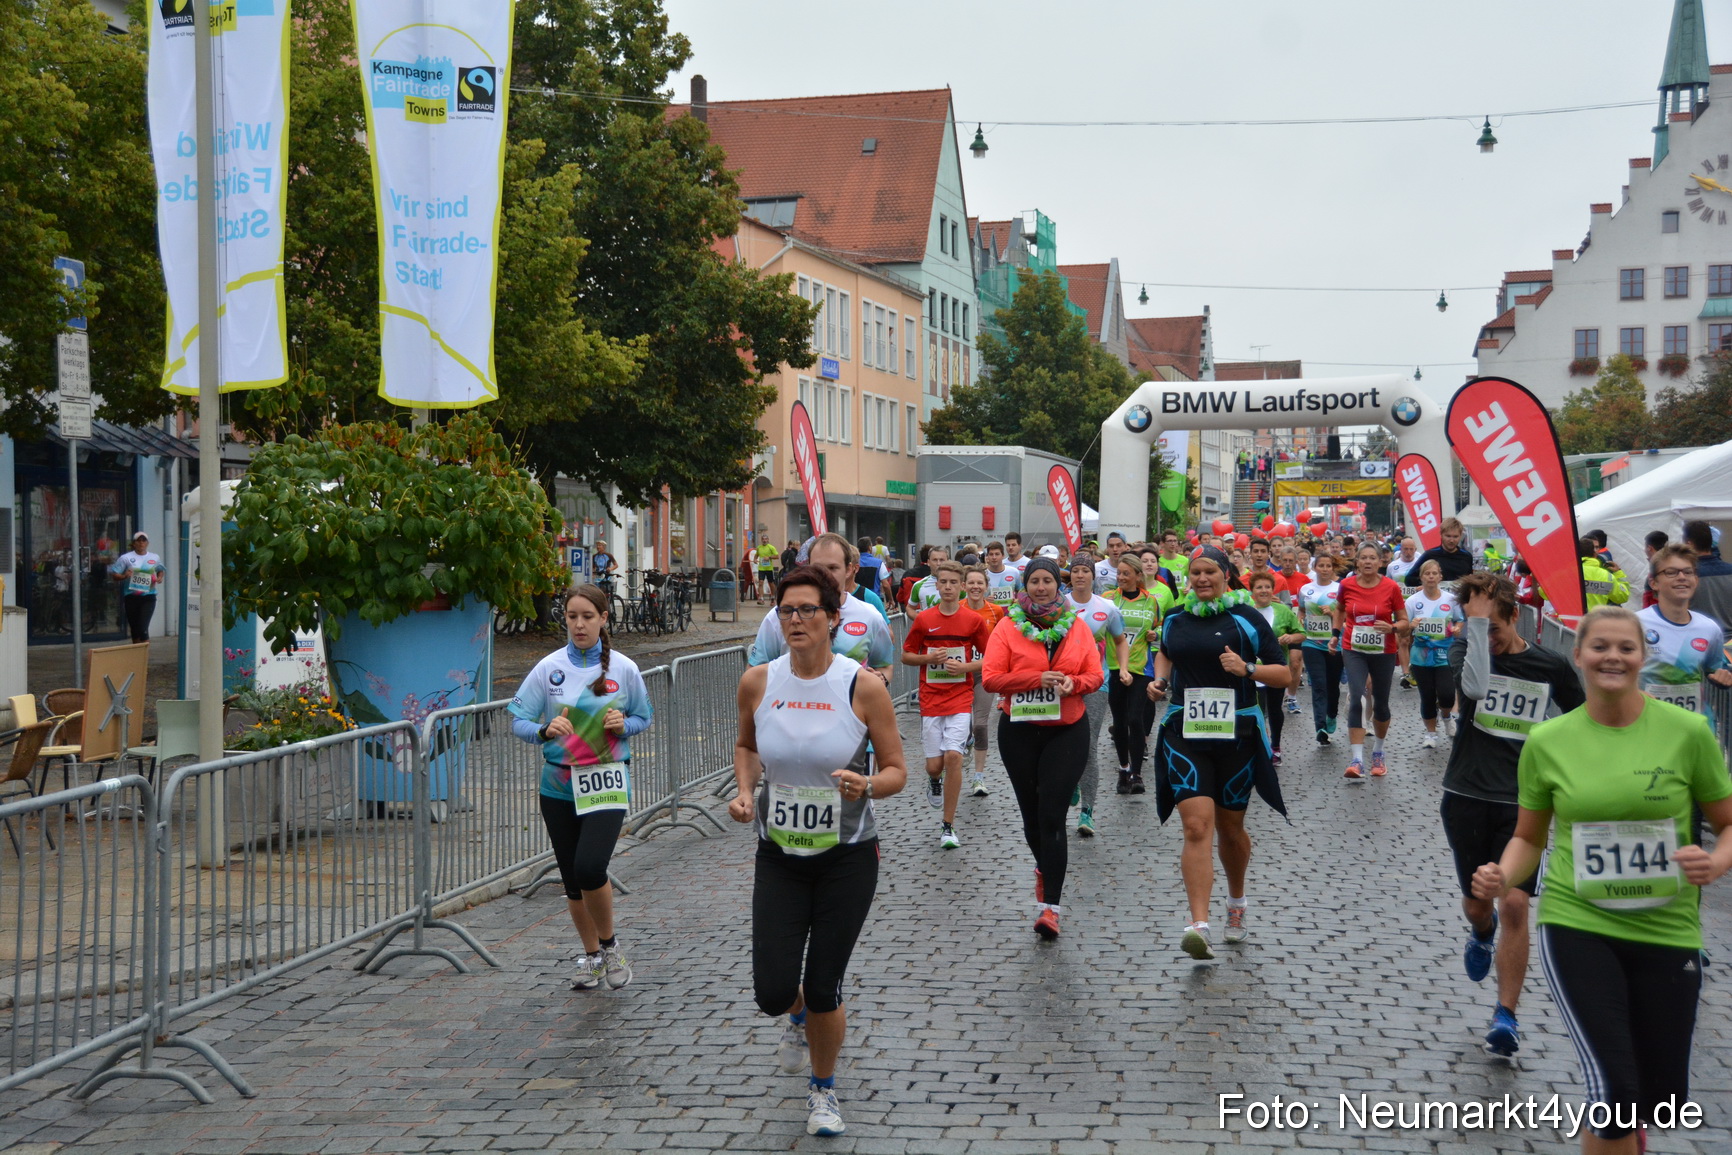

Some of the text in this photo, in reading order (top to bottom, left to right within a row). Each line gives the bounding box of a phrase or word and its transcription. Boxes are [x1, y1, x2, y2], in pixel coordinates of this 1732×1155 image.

[373, 62, 443, 82] Kampagne
[373, 75, 451, 97] Fairtrade
[406, 101, 445, 117] Towns
[458, 103, 494, 111] FAIRTRADE
[425, 195, 468, 219] sind
[60, 344, 87, 358] Parkschein
[63, 359, 85, 370] werktags
[1162, 387, 1380, 415] BMW Laufsport
[1463, 400, 1564, 547] REWE
[1320, 484, 1347, 493] ZIEL
[1402, 463, 1438, 534] REWE
[1052, 475, 1079, 545] REWE
[573, 552, 581, 563] P
[132, 575, 151, 585] 3095
[993, 591, 1011, 600] 5231
[1119, 609, 1154, 620] OCK
[846, 623, 866, 633] Hervis
[1308, 621, 1330, 631] 5248
[1418, 623, 1443, 633] 5005
[1354, 633, 1382, 645] 5085
[1015, 687, 1056, 704] 5048
[787, 701, 836, 711] KLEBL
[1188, 700, 1230, 719] 5147
[1484, 689, 1539, 719] 5191
[1022, 707, 1047, 715] Monika
[1194, 723, 1223, 731] Susanne
[1493, 718, 1520, 731] Adrian
[578, 770, 624, 794] 5069
[590, 794, 618, 805] Sabrina
[798, 788, 834, 798] BOCK
[774, 800, 834, 830] 5104
[787, 834, 814, 847] Petra
[1584, 841, 1669, 876] 5144
[1603, 883, 1653, 897] Yvonne
